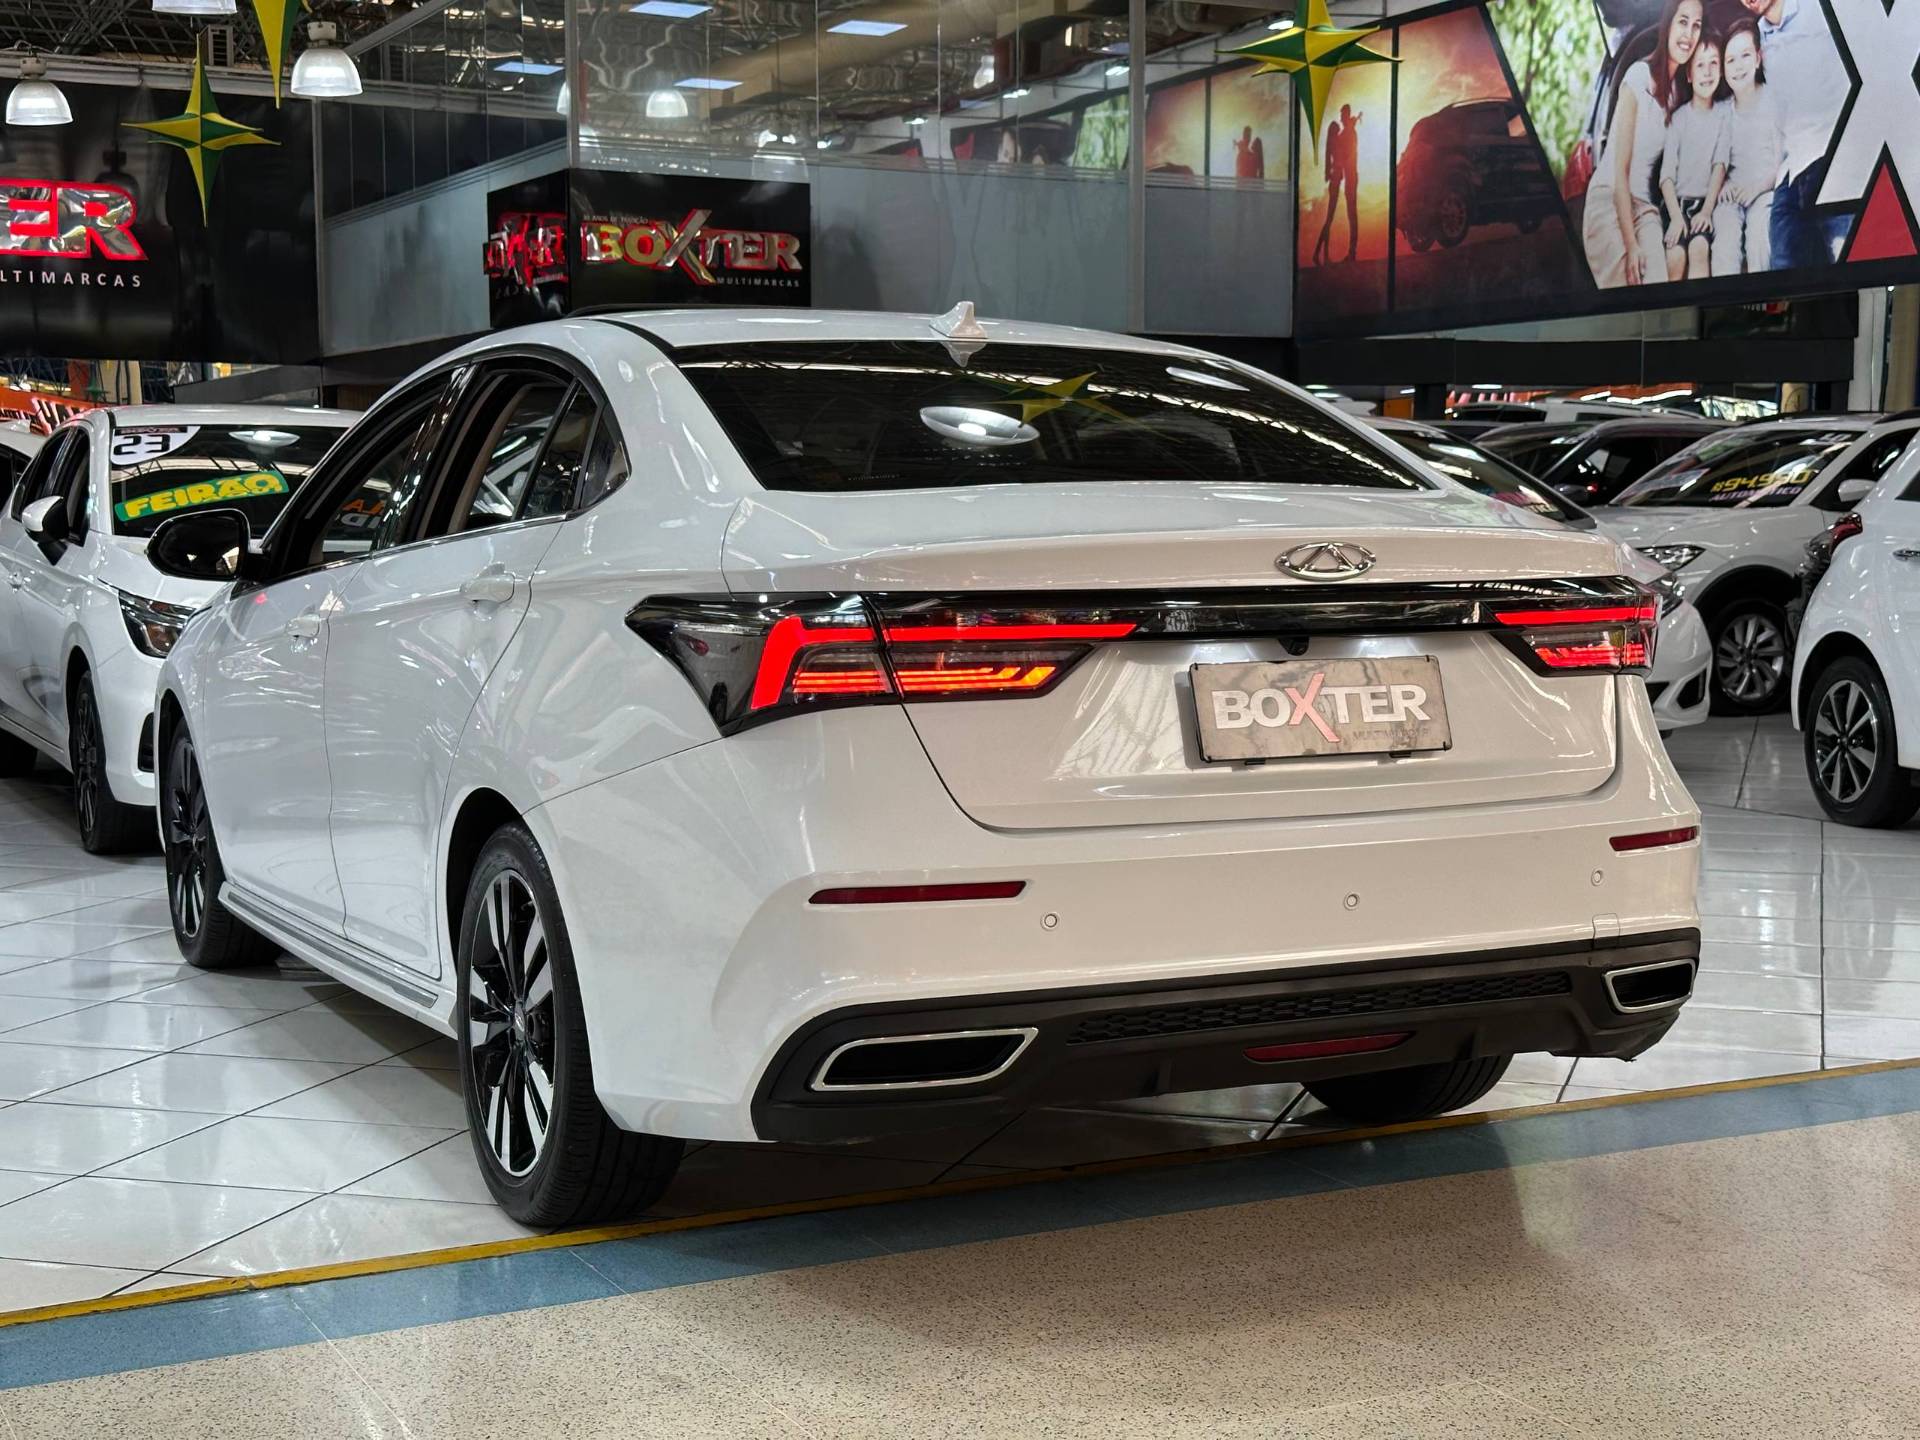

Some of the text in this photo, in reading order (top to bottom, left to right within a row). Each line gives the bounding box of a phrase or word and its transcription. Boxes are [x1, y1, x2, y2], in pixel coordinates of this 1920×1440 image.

[580, 208, 803, 285] BOXTER
[716, 277, 800, 288] MULTIMARCAS
[113, 434, 171, 456] 23
[1210, 672, 1432, 743] BOXTER
